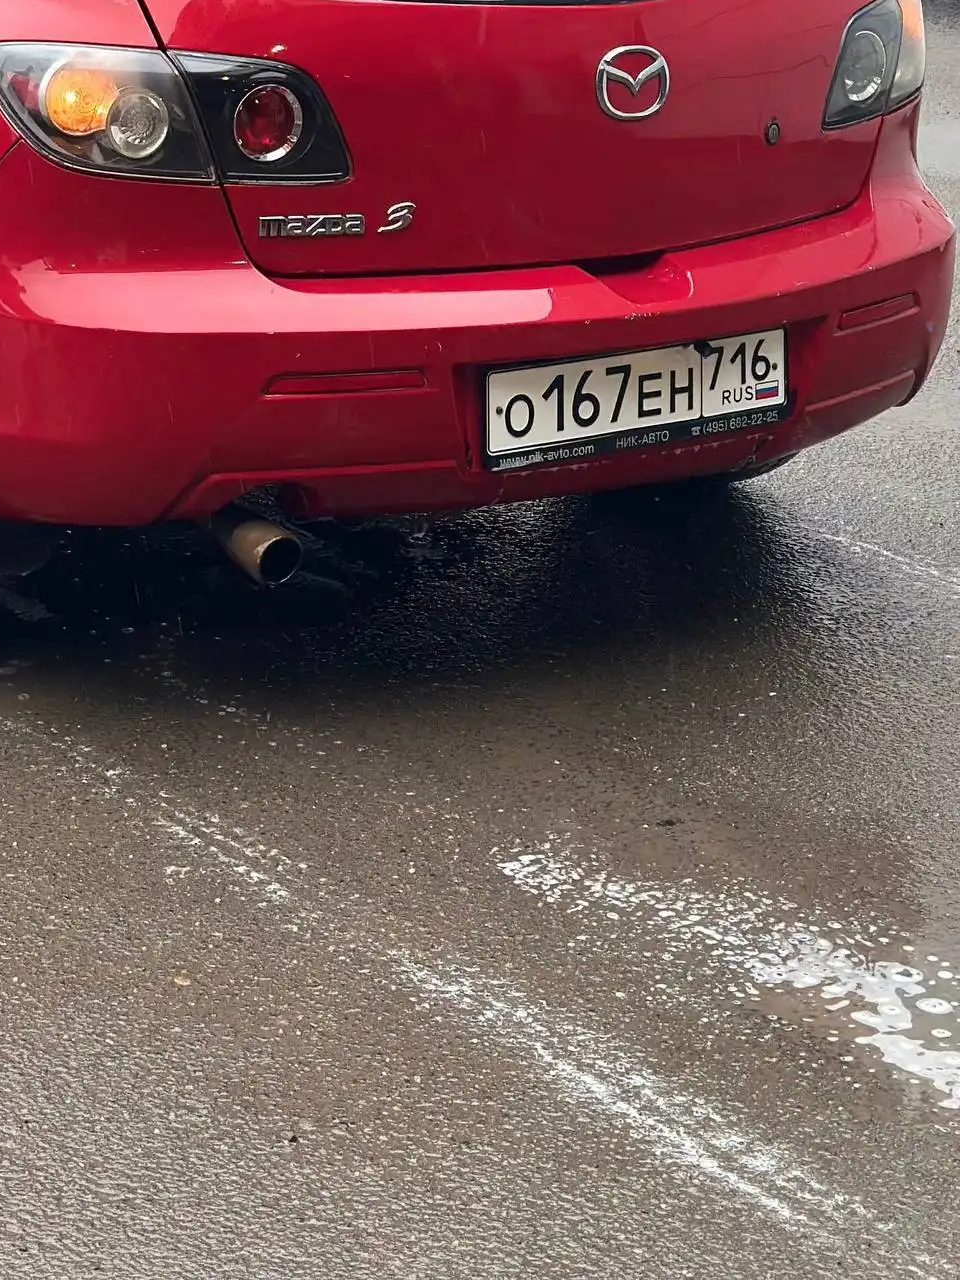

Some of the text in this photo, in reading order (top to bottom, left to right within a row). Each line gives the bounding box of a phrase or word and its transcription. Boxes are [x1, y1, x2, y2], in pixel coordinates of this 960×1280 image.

[259, 201, 416, 236] mazda 3
[709, 339, 771, 390] 716
[721, 386, 754, 405] RUS
[702, 420, 728, 436] (495)
[616, 430, 670, 449] НИК-АВТО
[499, 444, 595, 468] www.nik-avto.com
